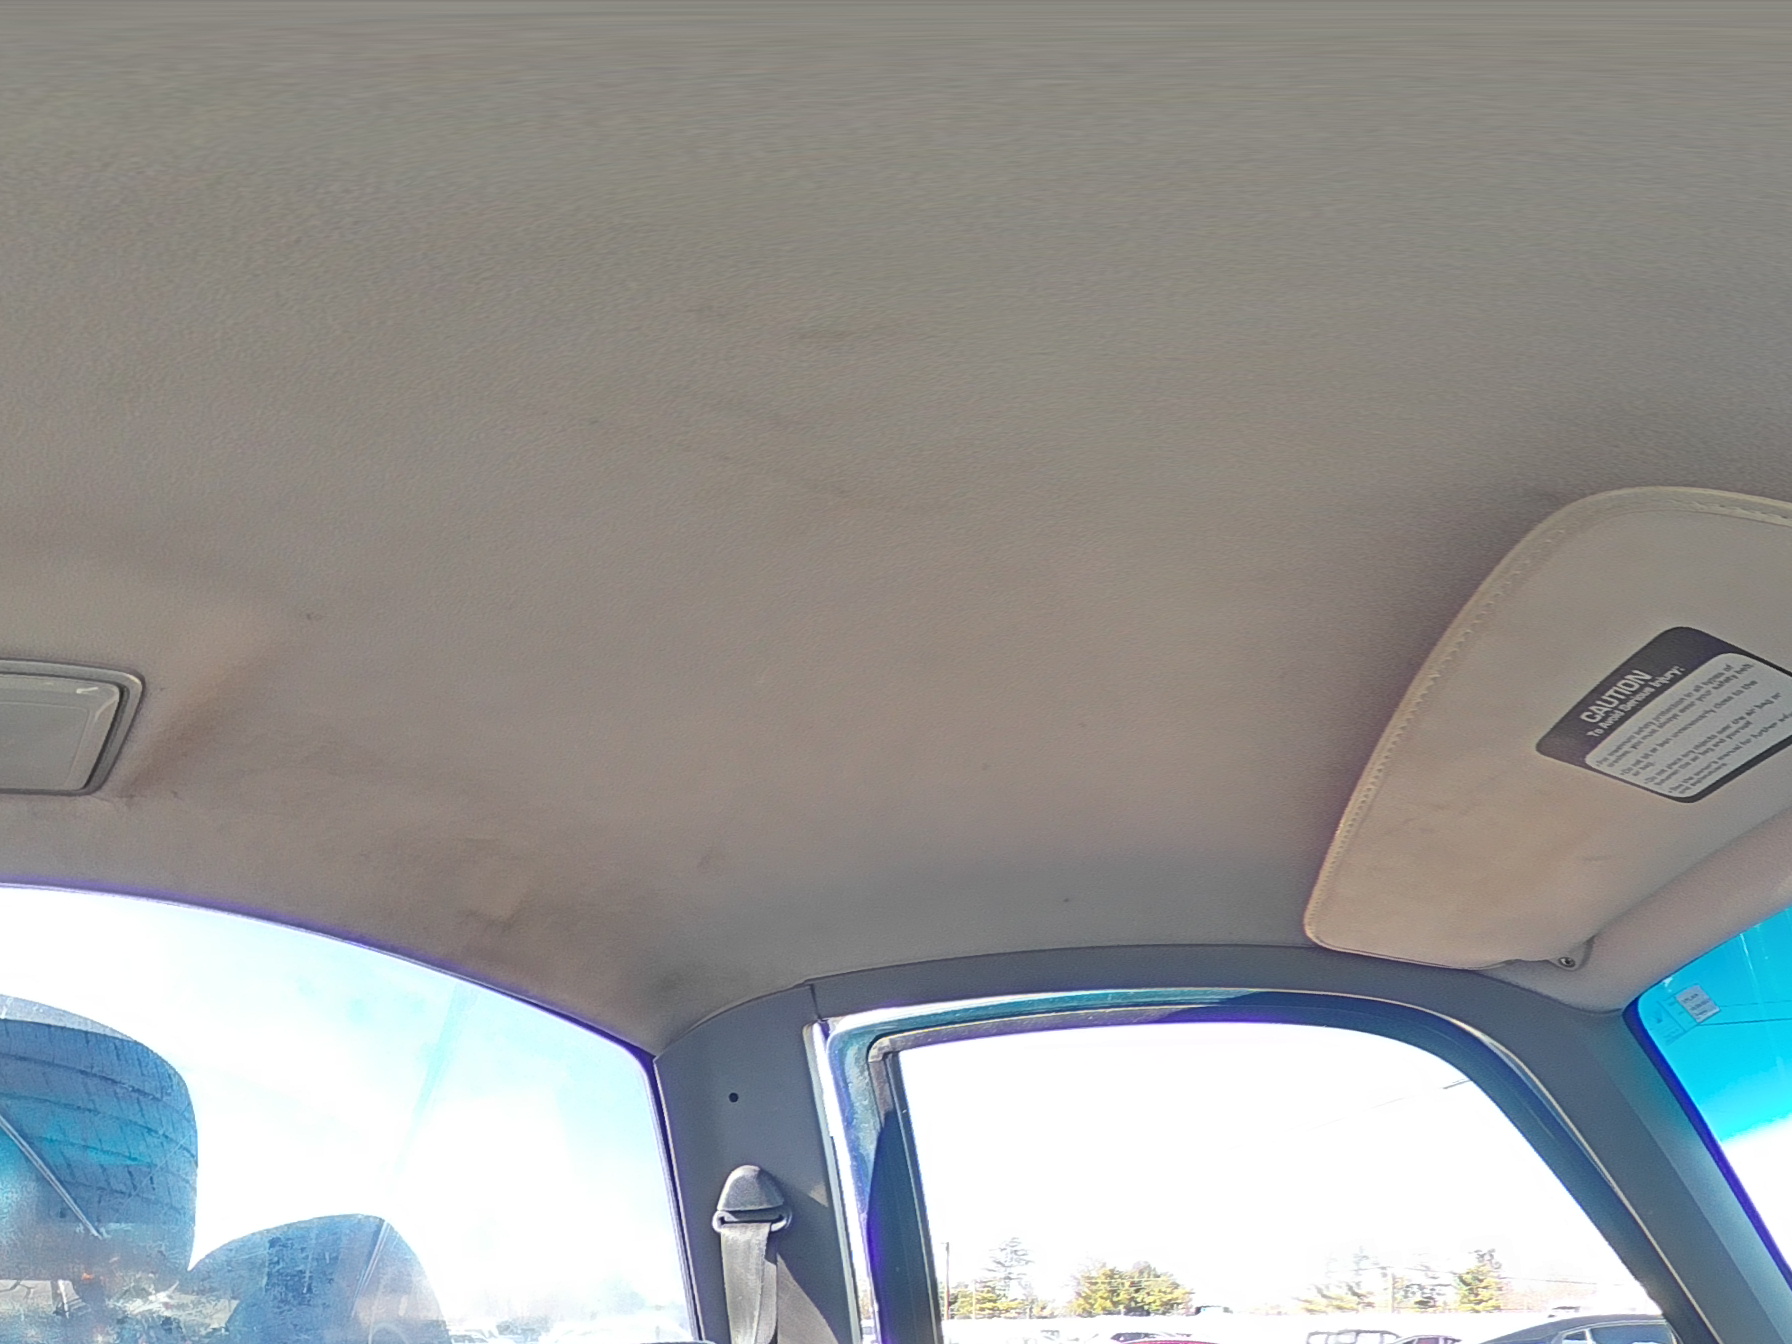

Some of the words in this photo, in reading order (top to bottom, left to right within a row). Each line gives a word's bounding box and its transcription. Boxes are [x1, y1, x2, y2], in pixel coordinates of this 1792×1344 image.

[1580, 669, 1653, 723] CAUTION
[1586, 727, 1604, 737] To
[1597, 710, 1624, 728] Avoid
[1617, 686, 1654, 711] Serious
[1648, 664, 1686, 688] Injury:
